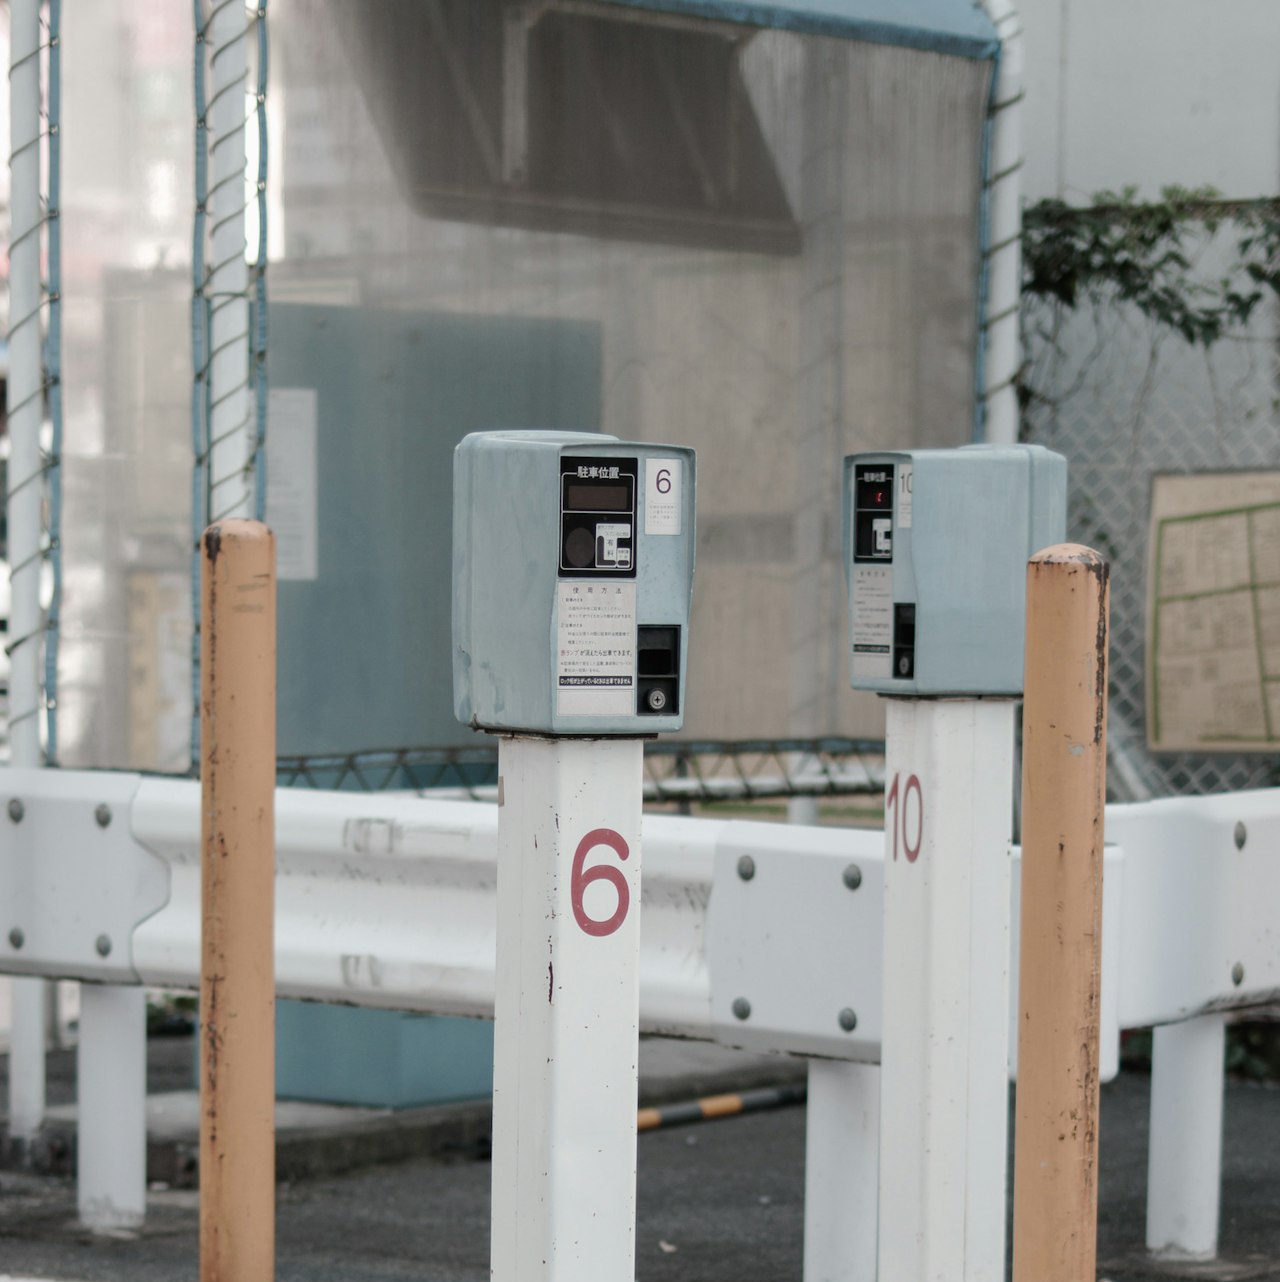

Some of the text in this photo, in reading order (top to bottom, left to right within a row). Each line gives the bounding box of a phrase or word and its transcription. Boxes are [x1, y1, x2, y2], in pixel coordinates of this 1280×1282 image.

[577, 466, 620, 480] 駐車位置
[656, 469, 672, 494] 6
[887, 771, 923, 864] 10
[570, 828, 630, 937] 6
